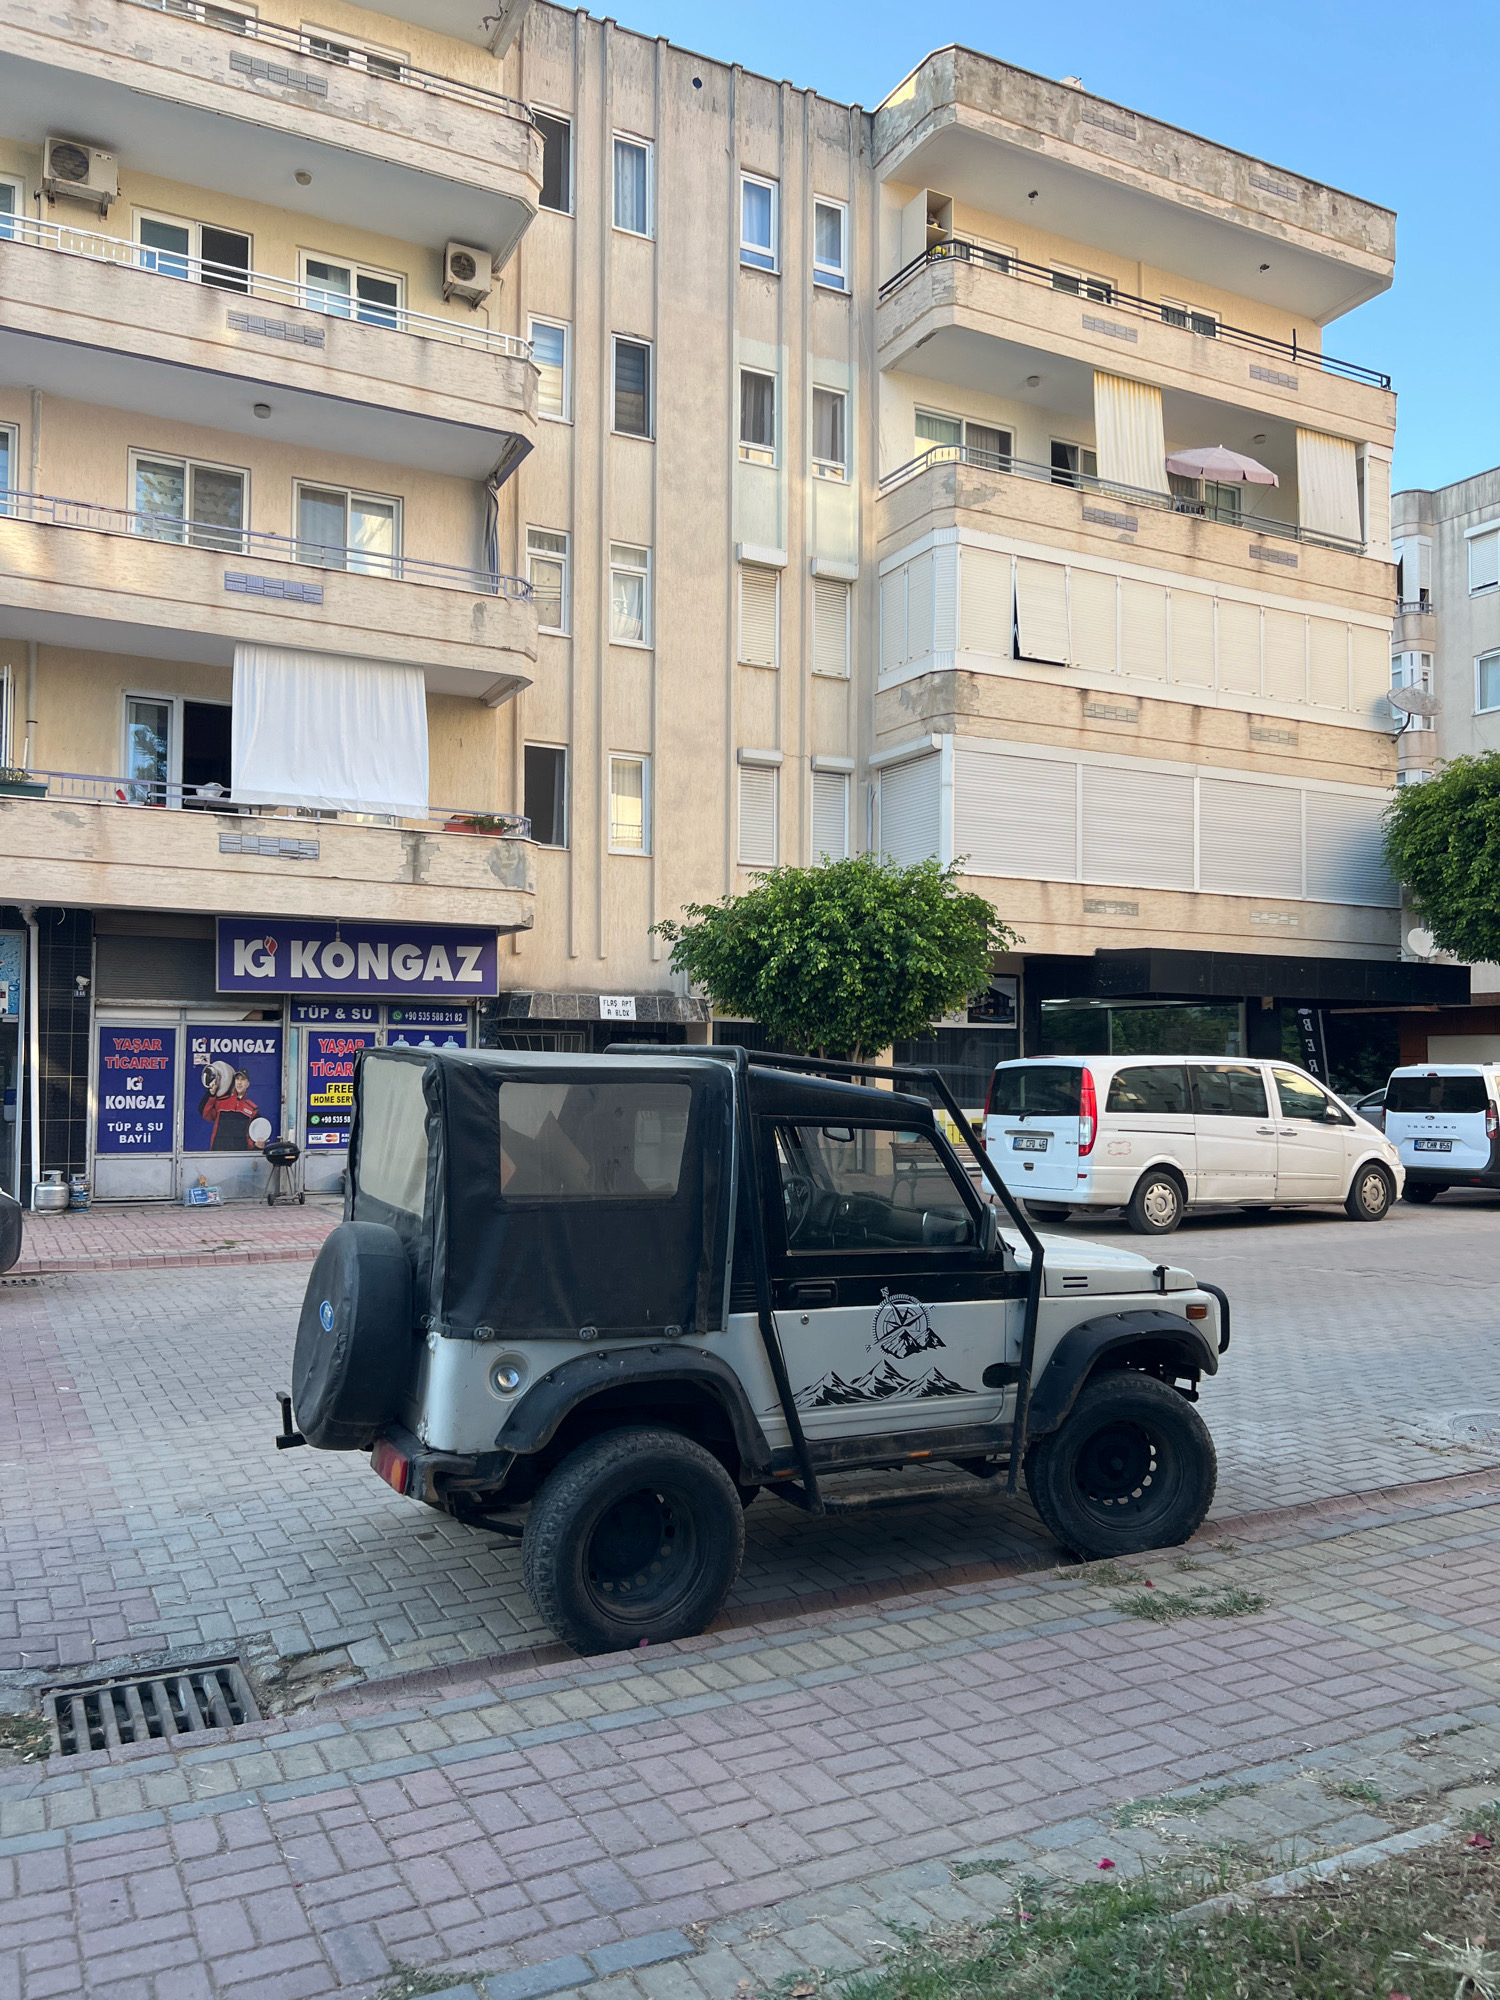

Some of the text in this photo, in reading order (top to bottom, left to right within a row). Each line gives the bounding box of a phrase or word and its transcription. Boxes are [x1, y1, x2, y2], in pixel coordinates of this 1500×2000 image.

[290, 940, 484, 982] KONGAZ
[297, 1005, 372, 1020] TÜP & SU
[405, 1011, 463, 1022] +90 535 588 21 82
[113, 1038, 162, 1053] YAŞAR
[210, 1038, 276, 1053] KONGAZ
[105, 1054, 168, 1069] TİCARET
[311, 1059, 354, 1077] TİCAR
[327, 1084, 354, 1094] FREE
[105, 1095, 165, 1109] KONGAZ
[313, 1095, 353, 1104] HOME SER
[107, 1121, 163, 1132] TÜP & SU
[119, 1132, 151, 1144] BAYİİ
